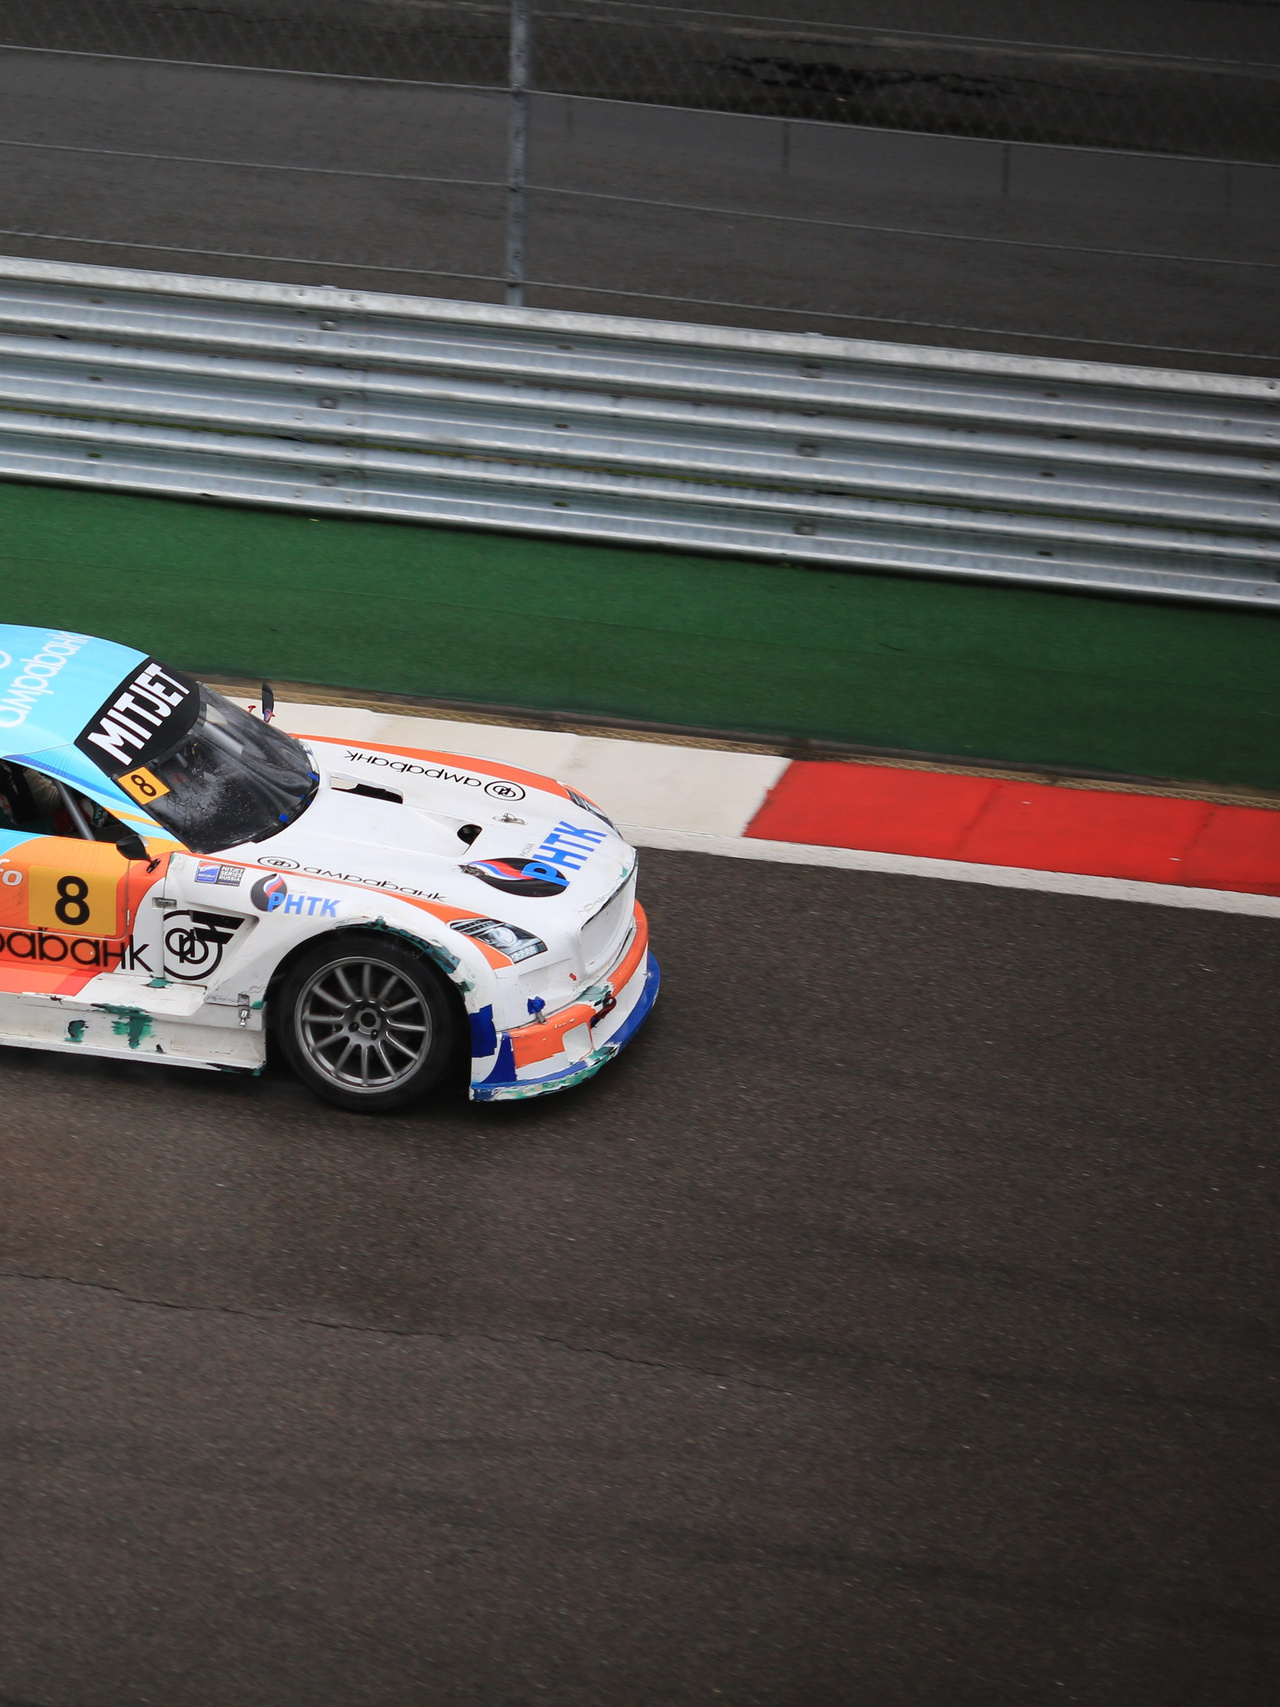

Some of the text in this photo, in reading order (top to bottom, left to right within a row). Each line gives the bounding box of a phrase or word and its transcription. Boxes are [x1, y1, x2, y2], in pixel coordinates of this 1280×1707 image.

[87, 662, 190, 766] MITJET
[130, 774, 157, 797] 8
[521, 820, 608, 887] РНТК
[54, 875, 91, 926] 8
[267, 891, 341, 918] РНТК
